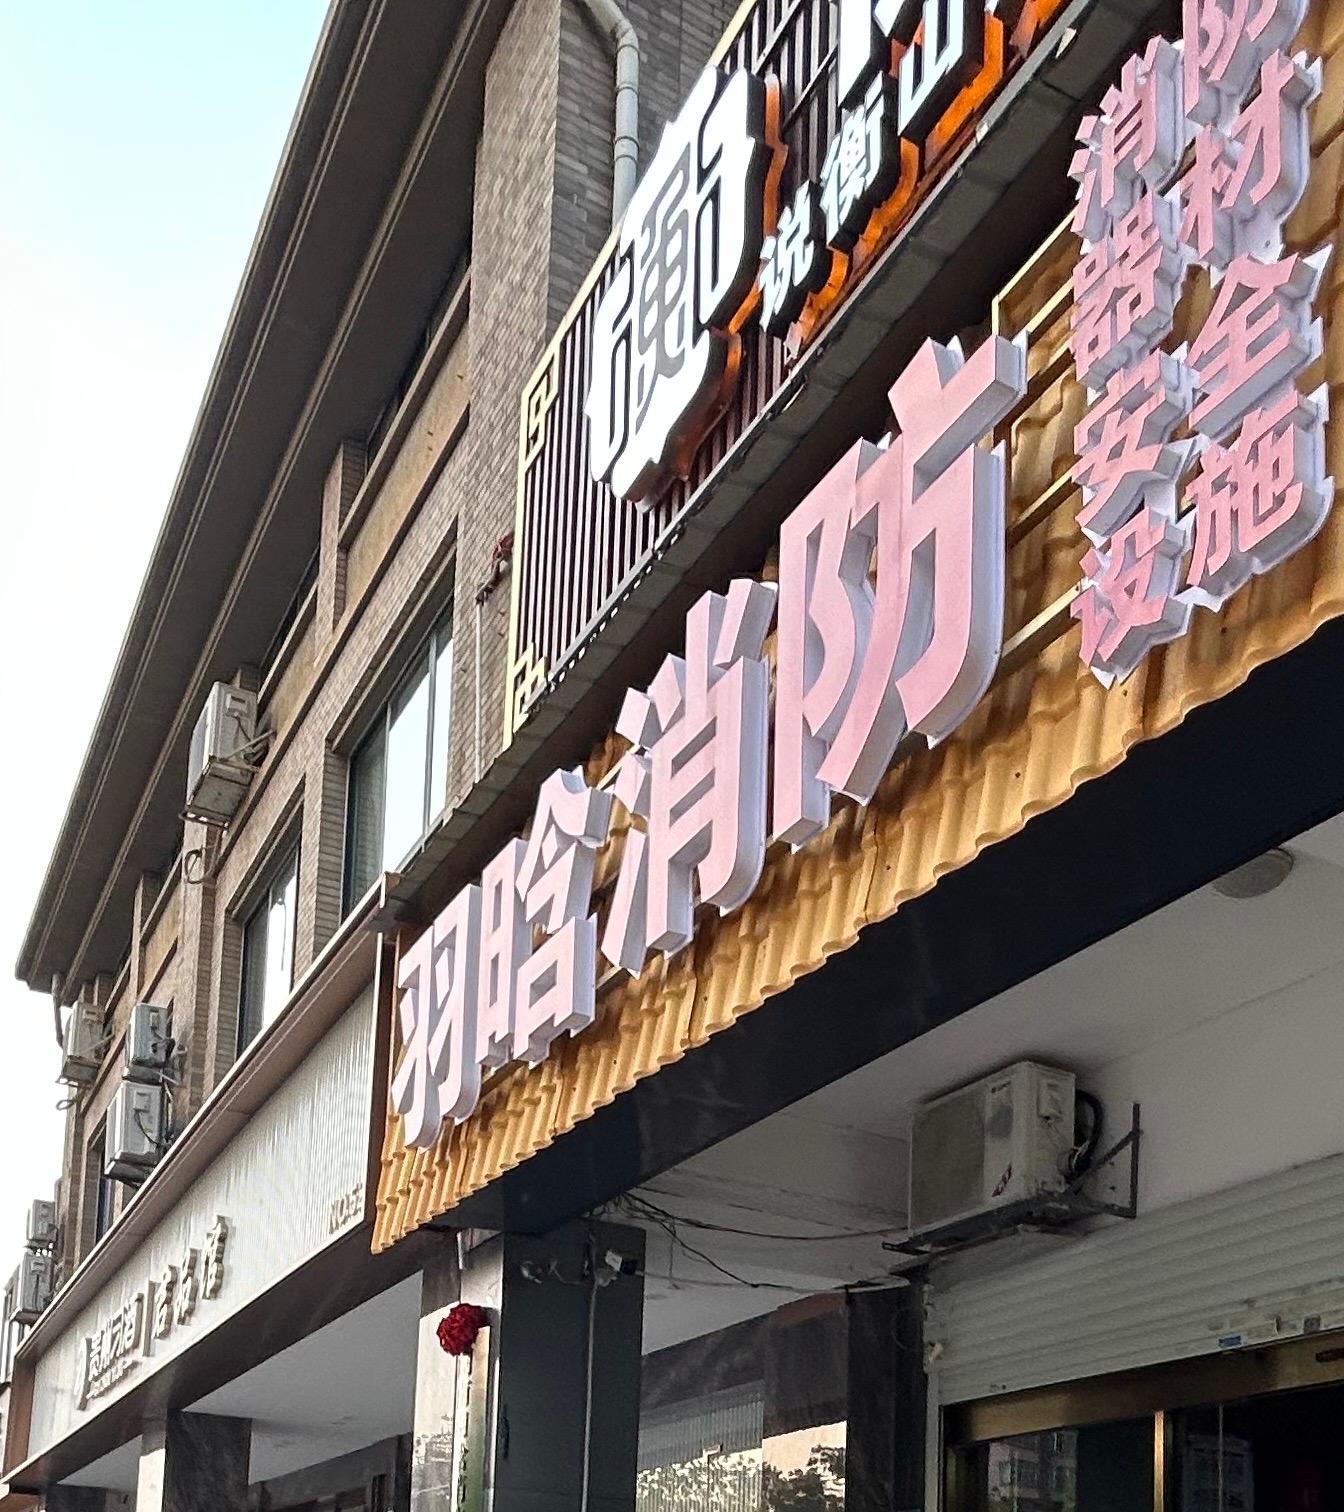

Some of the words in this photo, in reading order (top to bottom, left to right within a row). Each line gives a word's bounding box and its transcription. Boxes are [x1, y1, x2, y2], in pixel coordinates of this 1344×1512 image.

[760, 0, 999, 332] 说衡山
[392, 336, 1022, 1148] 羽晗消防
